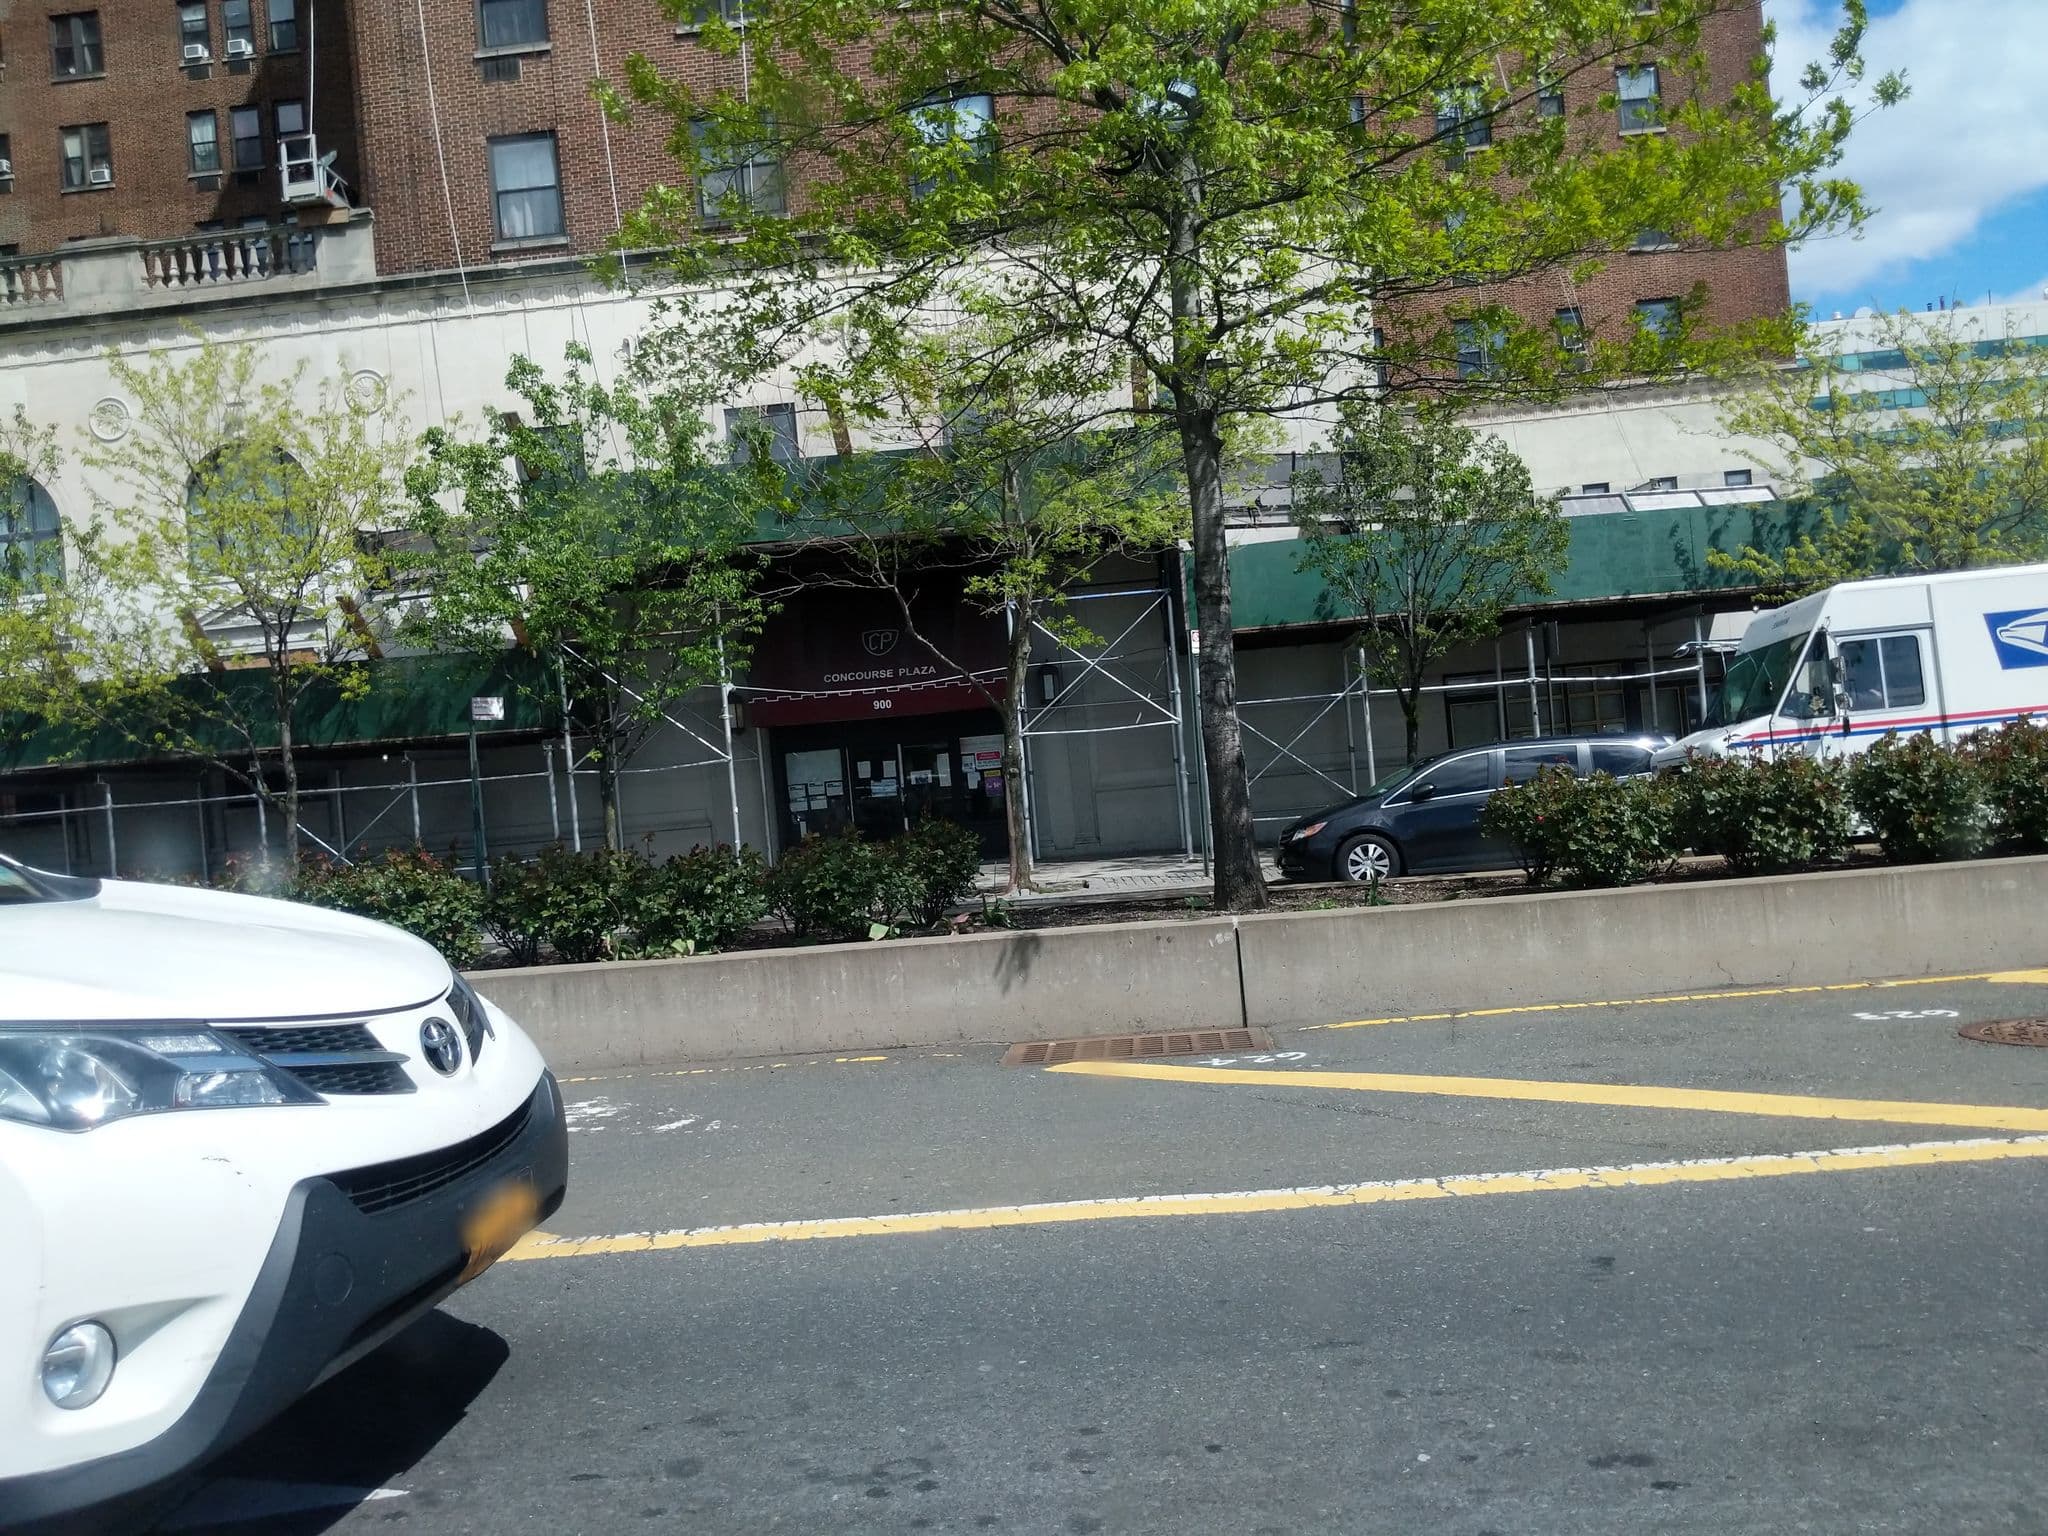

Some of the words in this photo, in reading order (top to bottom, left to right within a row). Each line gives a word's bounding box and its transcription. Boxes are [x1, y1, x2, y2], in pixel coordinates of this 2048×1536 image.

[823, 669, 894, 683] CONCOURSE
[899, 666, 936, 676] PLAZA
[873, 700, 892, 710] 900
